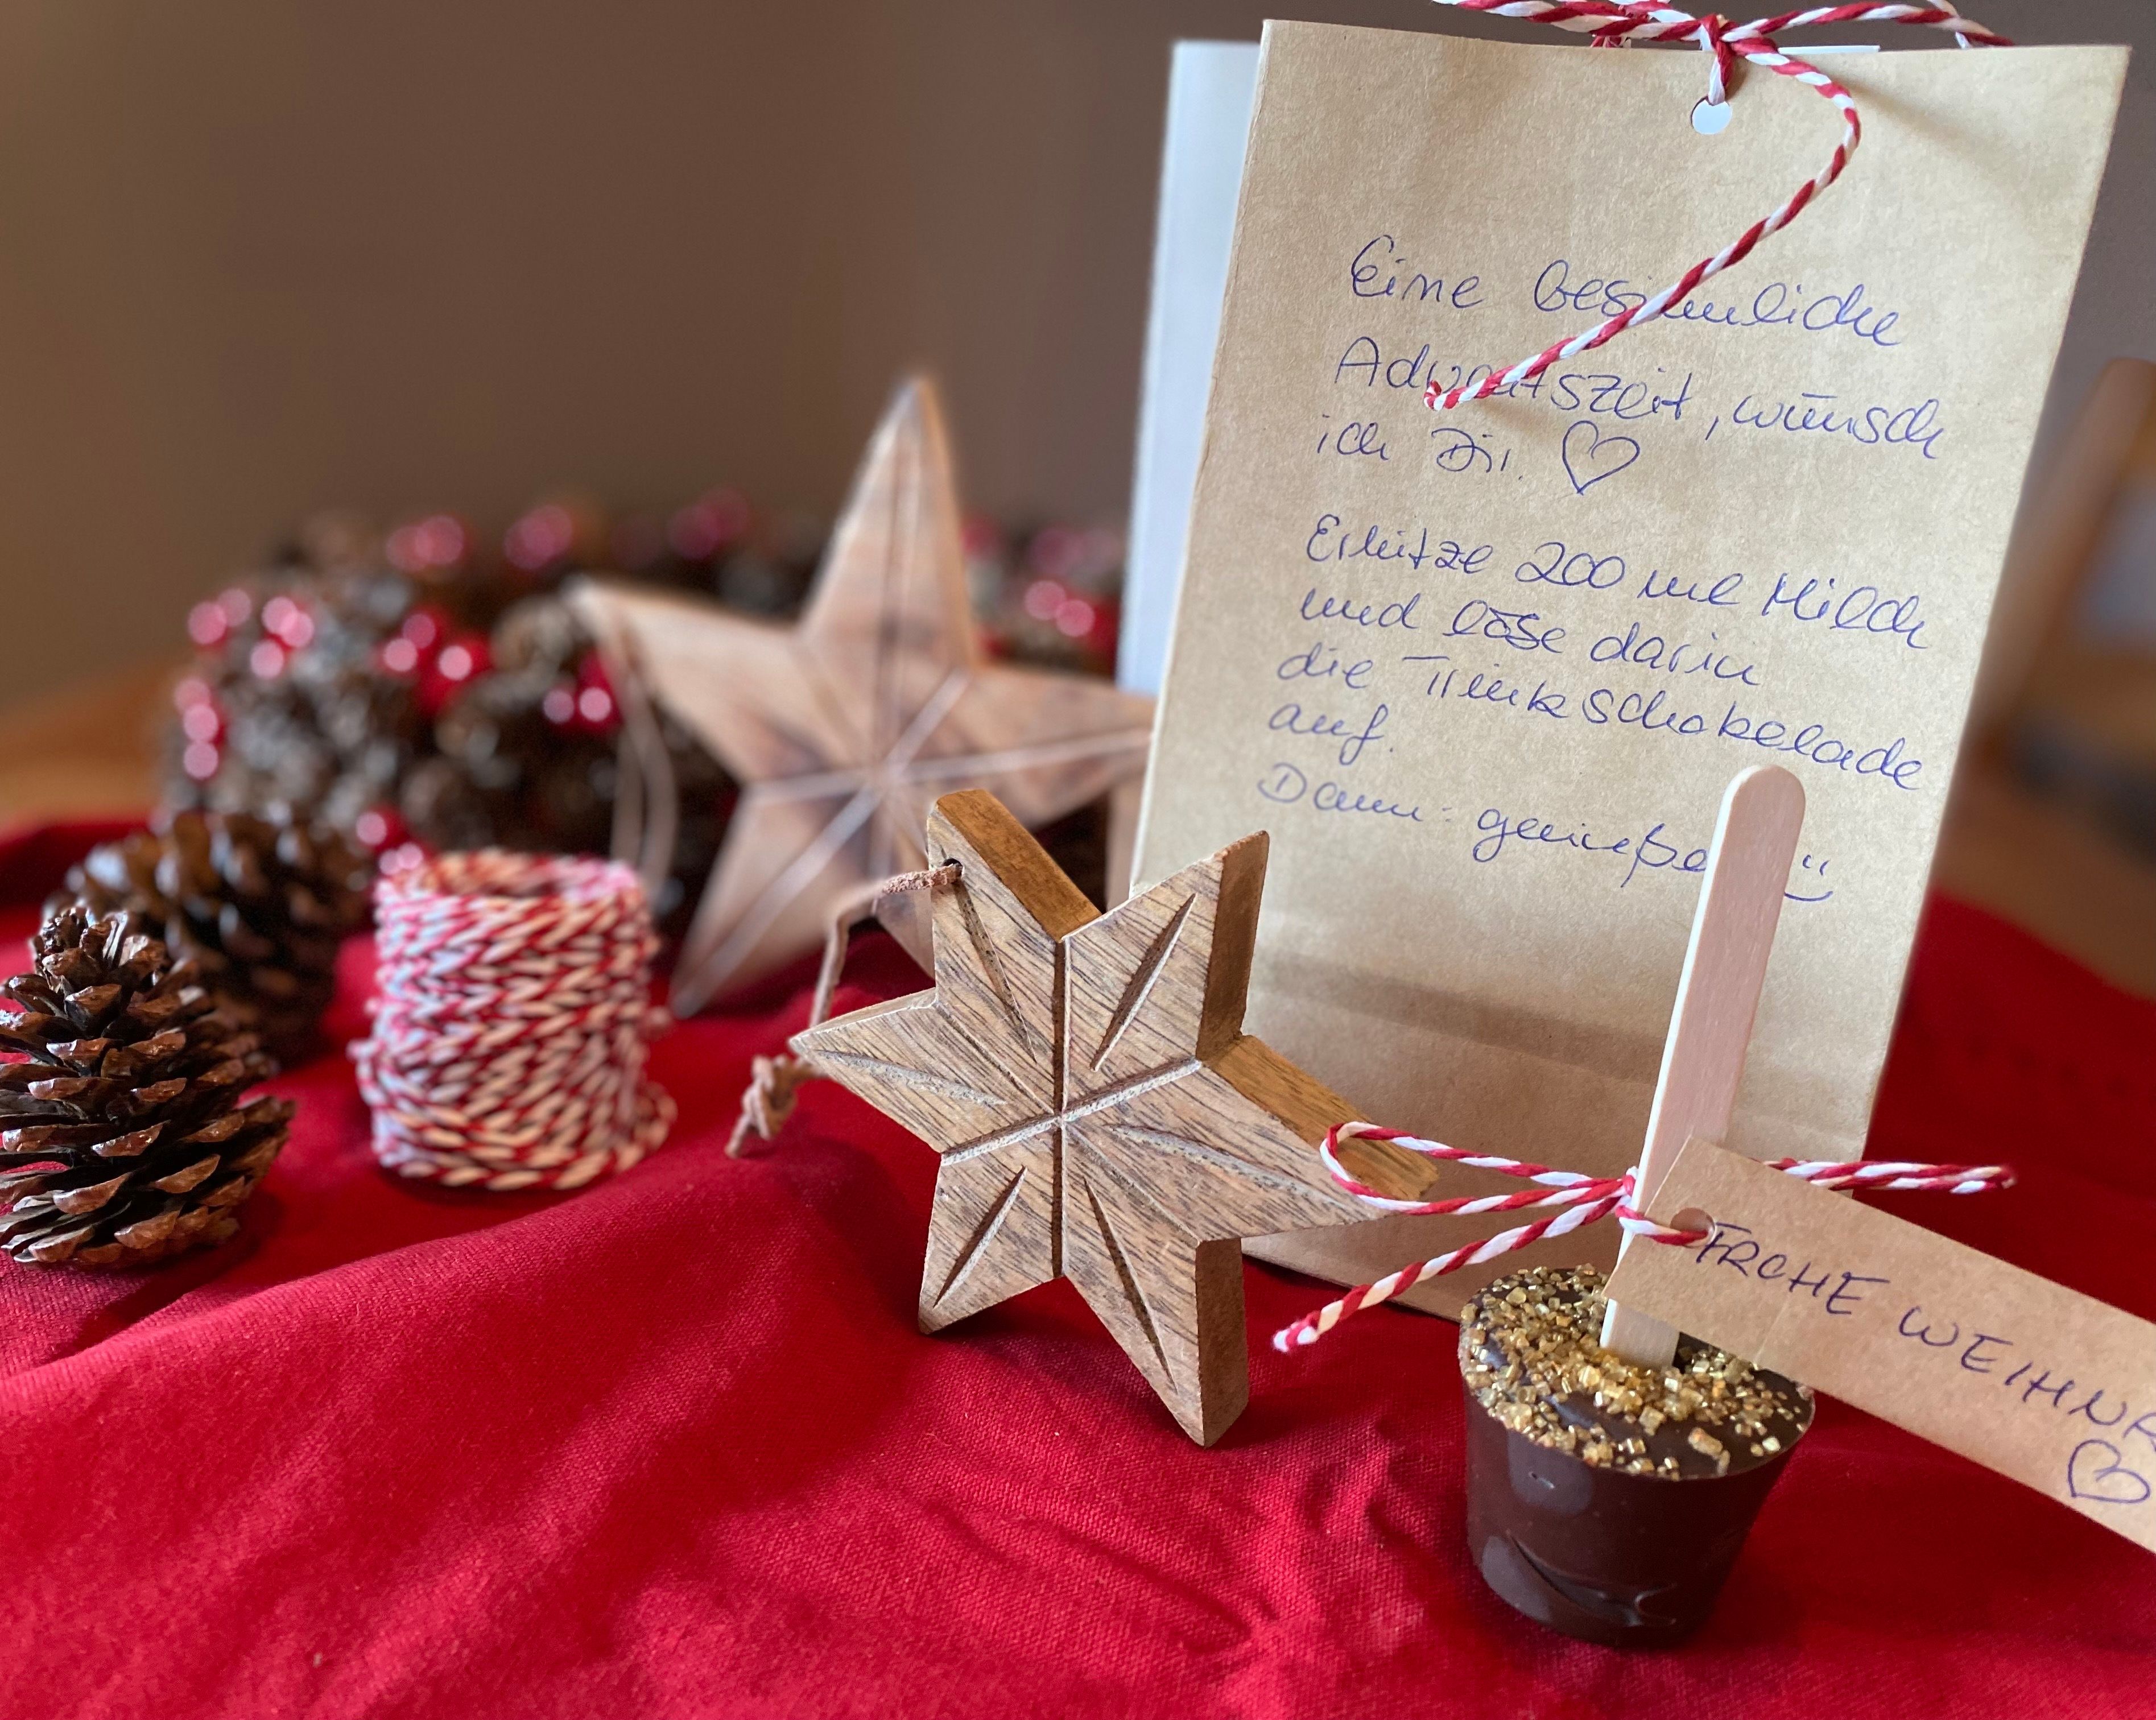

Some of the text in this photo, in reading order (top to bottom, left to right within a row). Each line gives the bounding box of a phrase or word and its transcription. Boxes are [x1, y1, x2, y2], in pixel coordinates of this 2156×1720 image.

[1351, 235, 1485, 308] Eine
[1317, 415, 1389, 460] ich
[1307, 514, 1493, 574] Erhitze
[1515, 541, 1626, 589] 200
[1761, 572, 1928, 649] Milch
[1277, 642, 1373, 689] die
[1591, 622, 1761, 685] darin
[1473, 808, 1707, 888] genieße
[1696, 1222, 1890, 1315] FROHE
